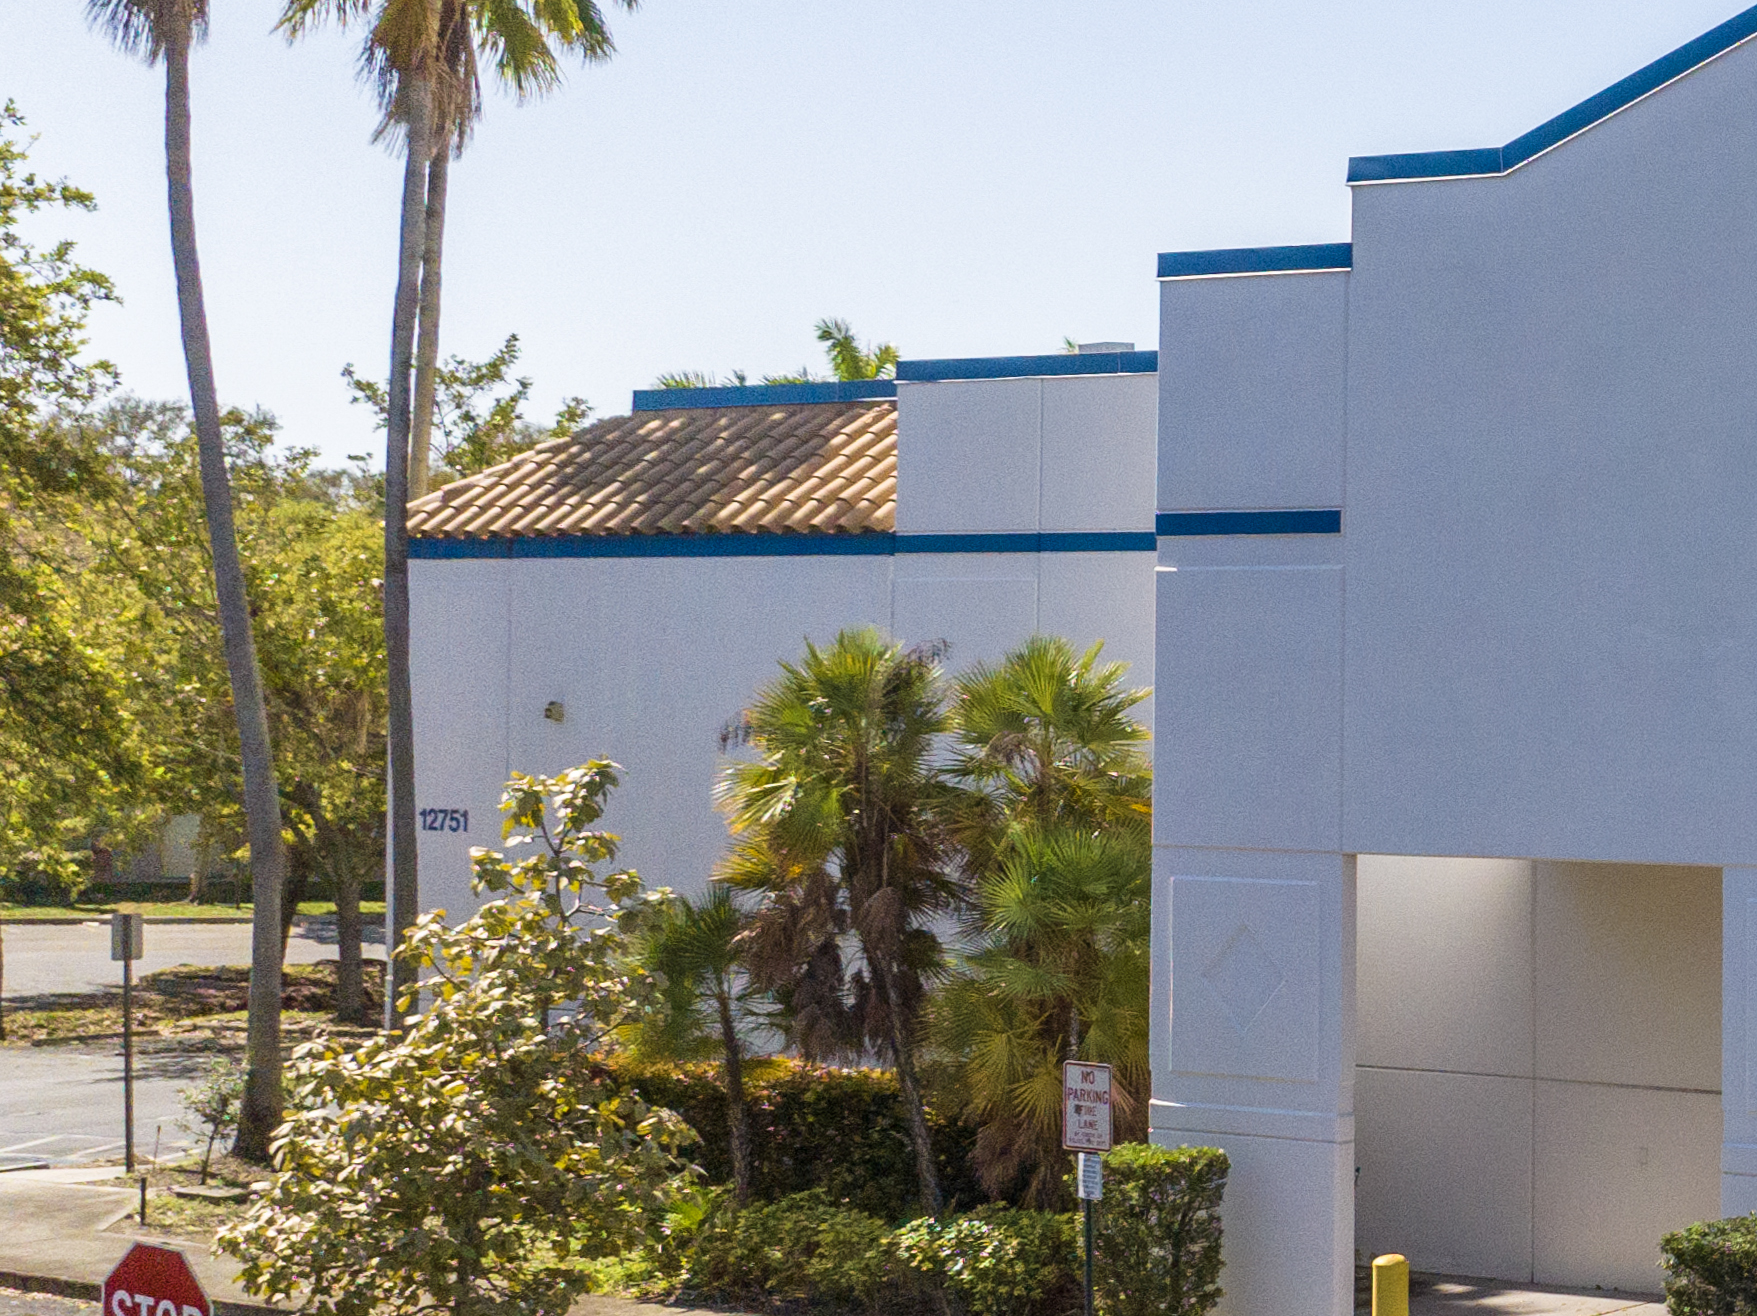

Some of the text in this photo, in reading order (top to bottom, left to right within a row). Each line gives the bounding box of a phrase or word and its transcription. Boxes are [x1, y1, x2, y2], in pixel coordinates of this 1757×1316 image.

[420, 809, 469, 833] 12751
[1081, 1070, 1095, 1085] NO
[1067, 1087, 1109, 1105] PARKING
[1078, 1119, 1098, 1131] LANE
